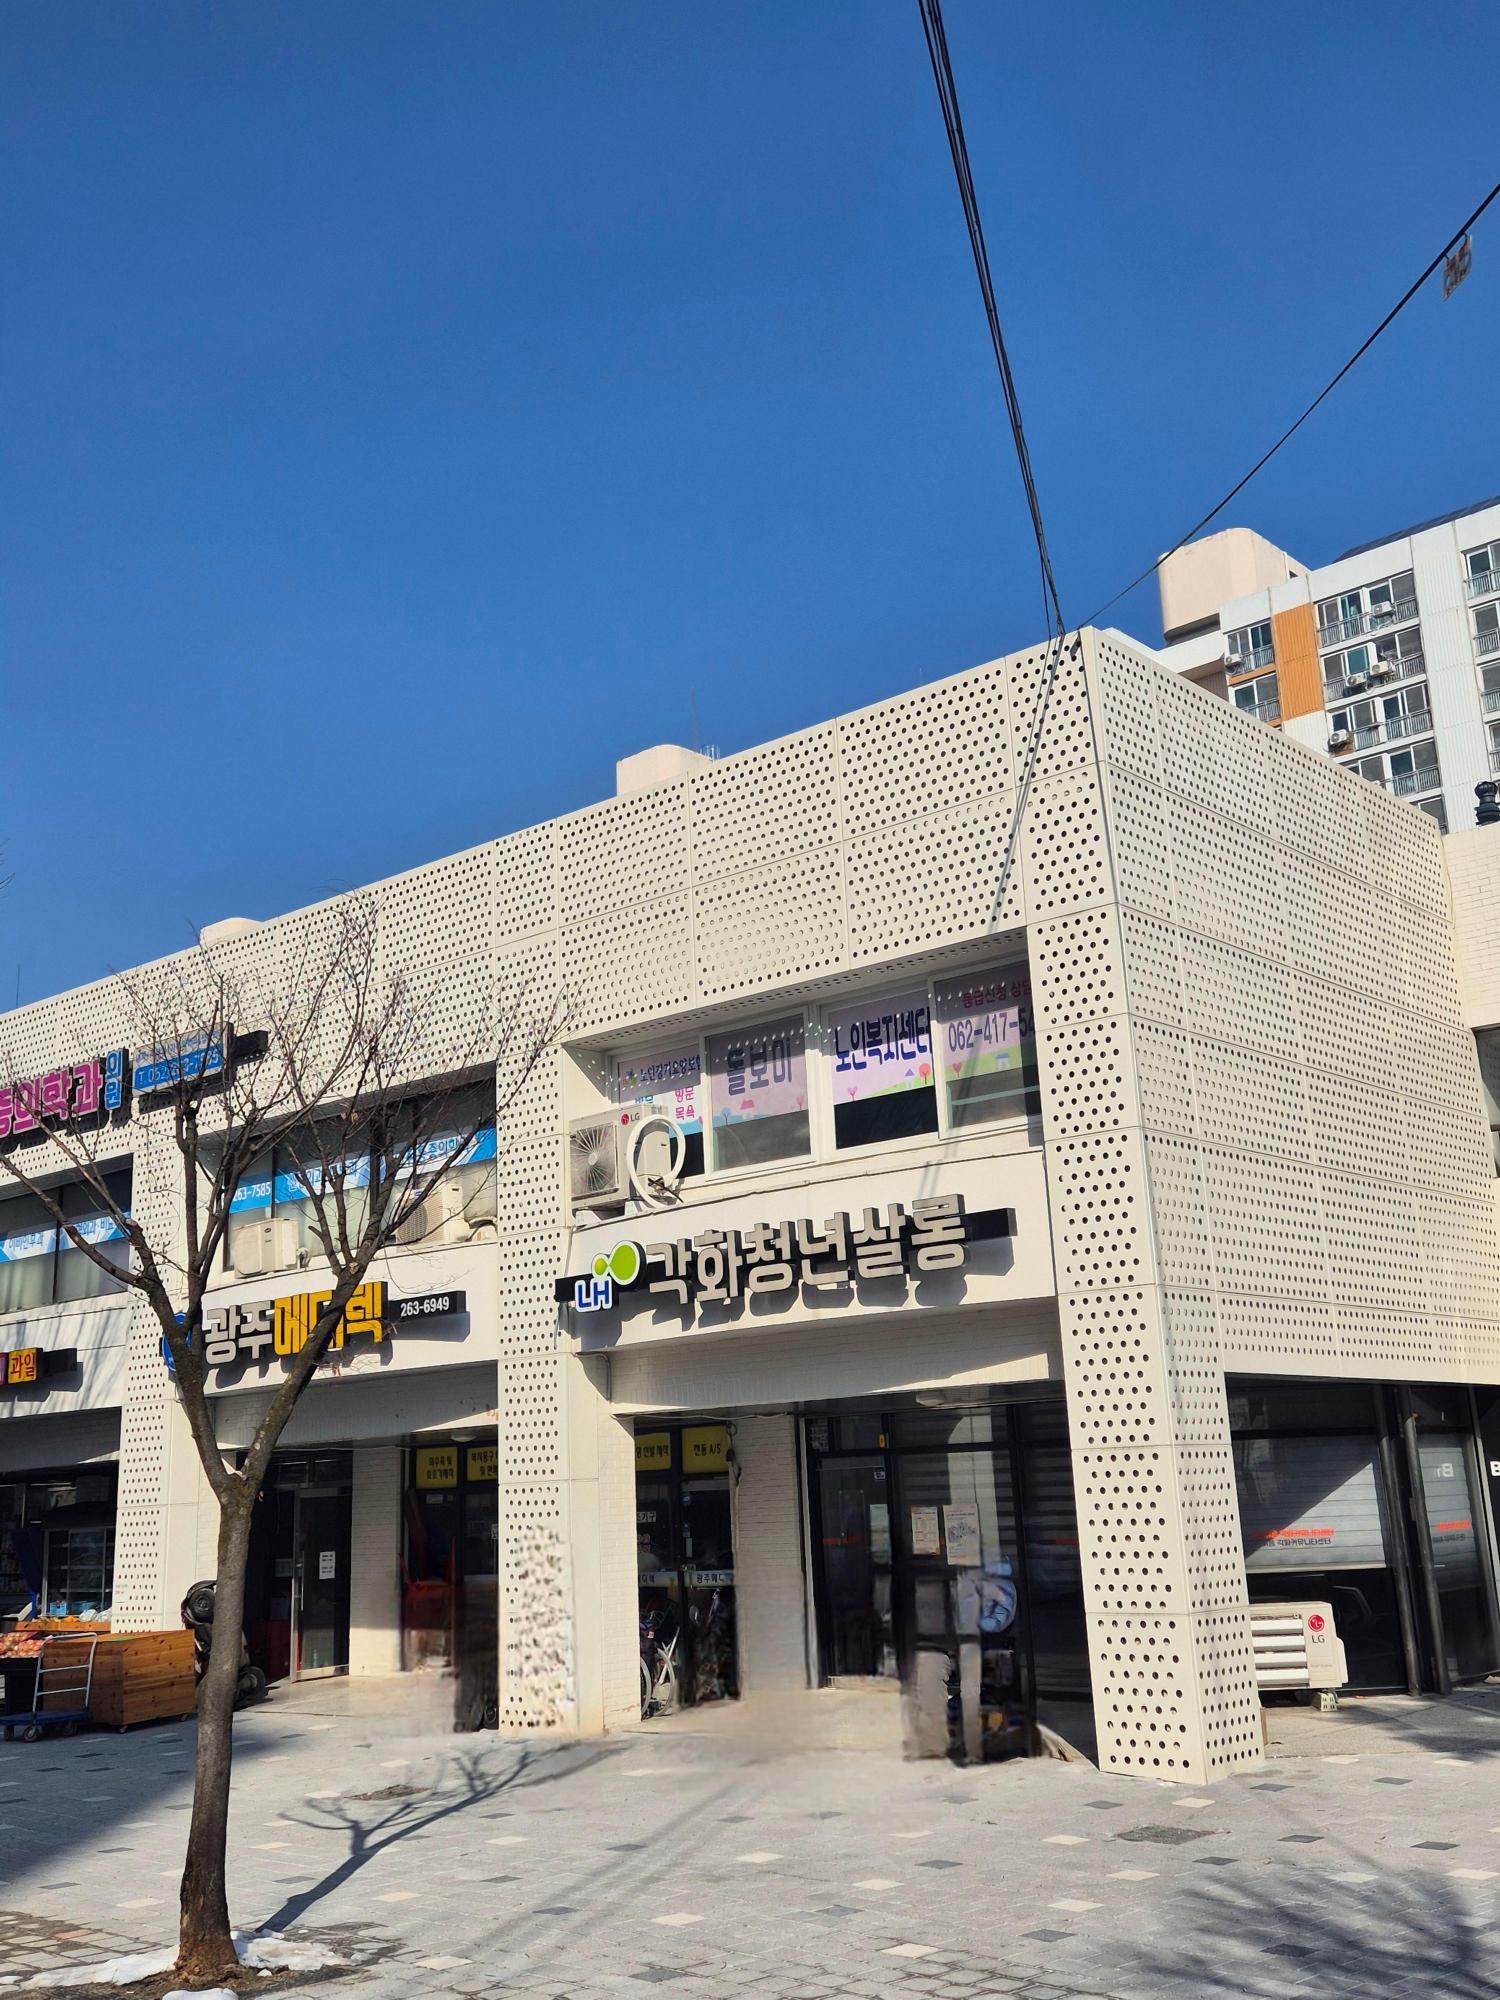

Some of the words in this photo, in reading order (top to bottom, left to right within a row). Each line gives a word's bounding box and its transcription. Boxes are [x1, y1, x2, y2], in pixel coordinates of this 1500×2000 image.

[727, 1037, 792, 1096] 돌보미
[630, 1112, 640, 1122] LG
[646, 1193, 967, 1304] 각화청년살롱
[400, 1296, 450, 1317] 263-6949
[576, 1278, 612, 1311] LH
[12, 1352, 35, 1379] 과일
